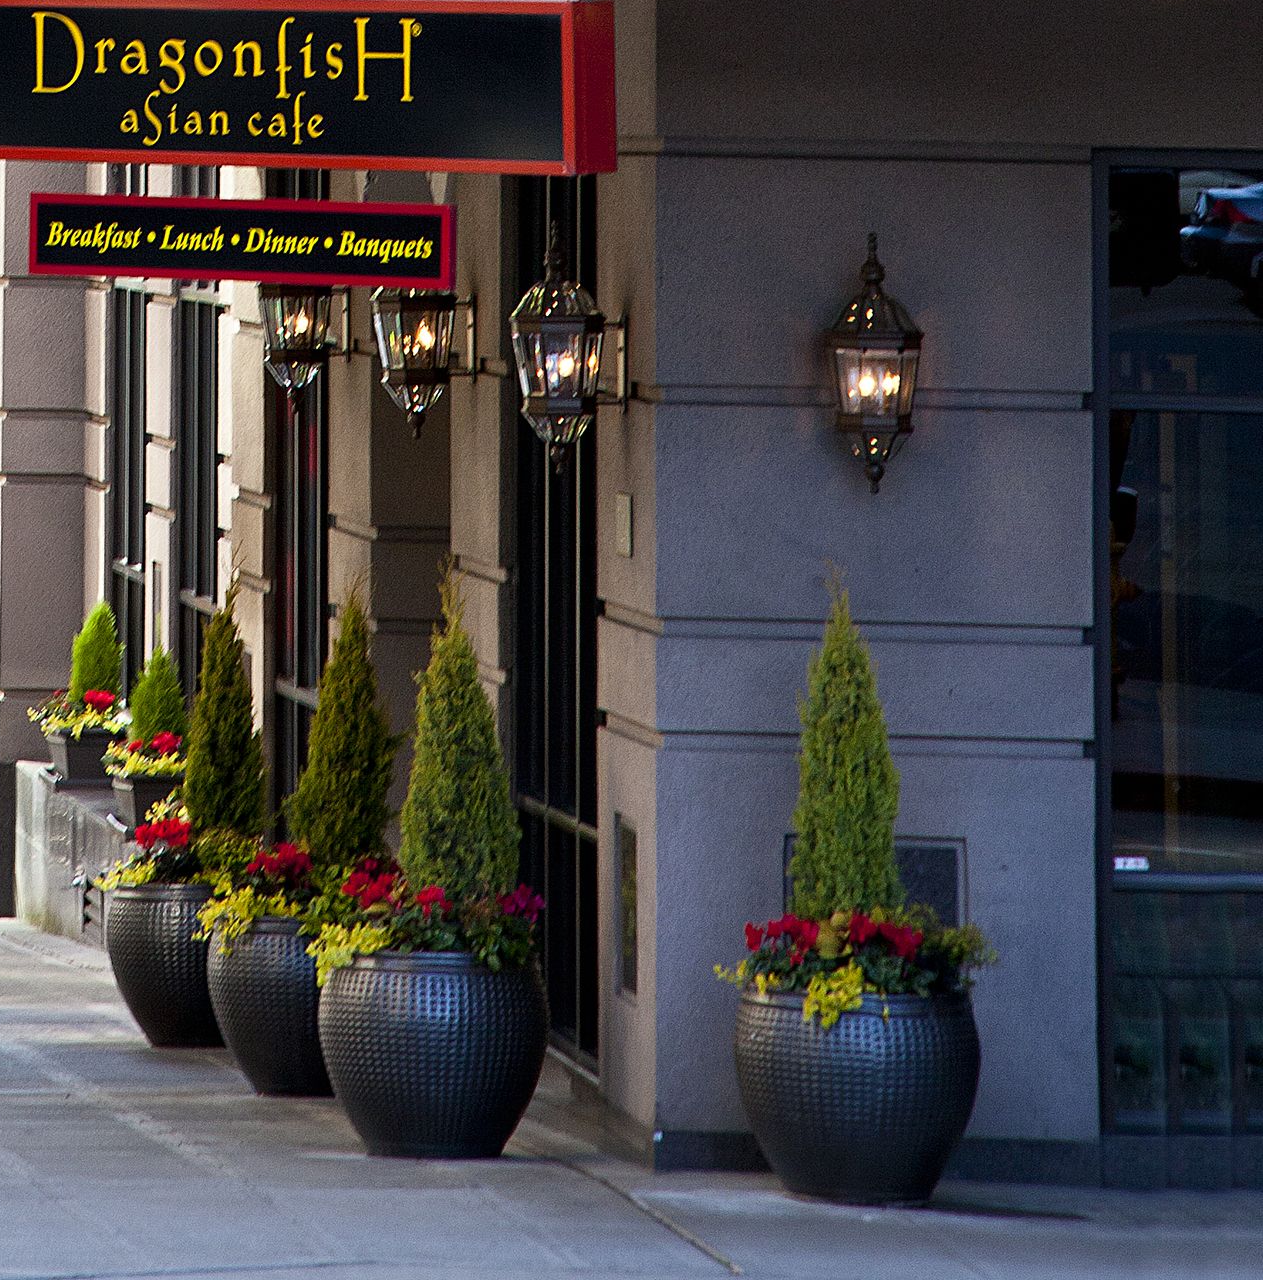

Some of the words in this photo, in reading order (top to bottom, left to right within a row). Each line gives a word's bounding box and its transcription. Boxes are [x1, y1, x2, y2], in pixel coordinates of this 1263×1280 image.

[247, 91, 325, 145] cafe
[45, 221, 142, 253] Breakfast
[160, 225, 225, 252] Lunch
[243, 227, 319, 255] Dinner
[336, 230, 434, 263] Banquets
